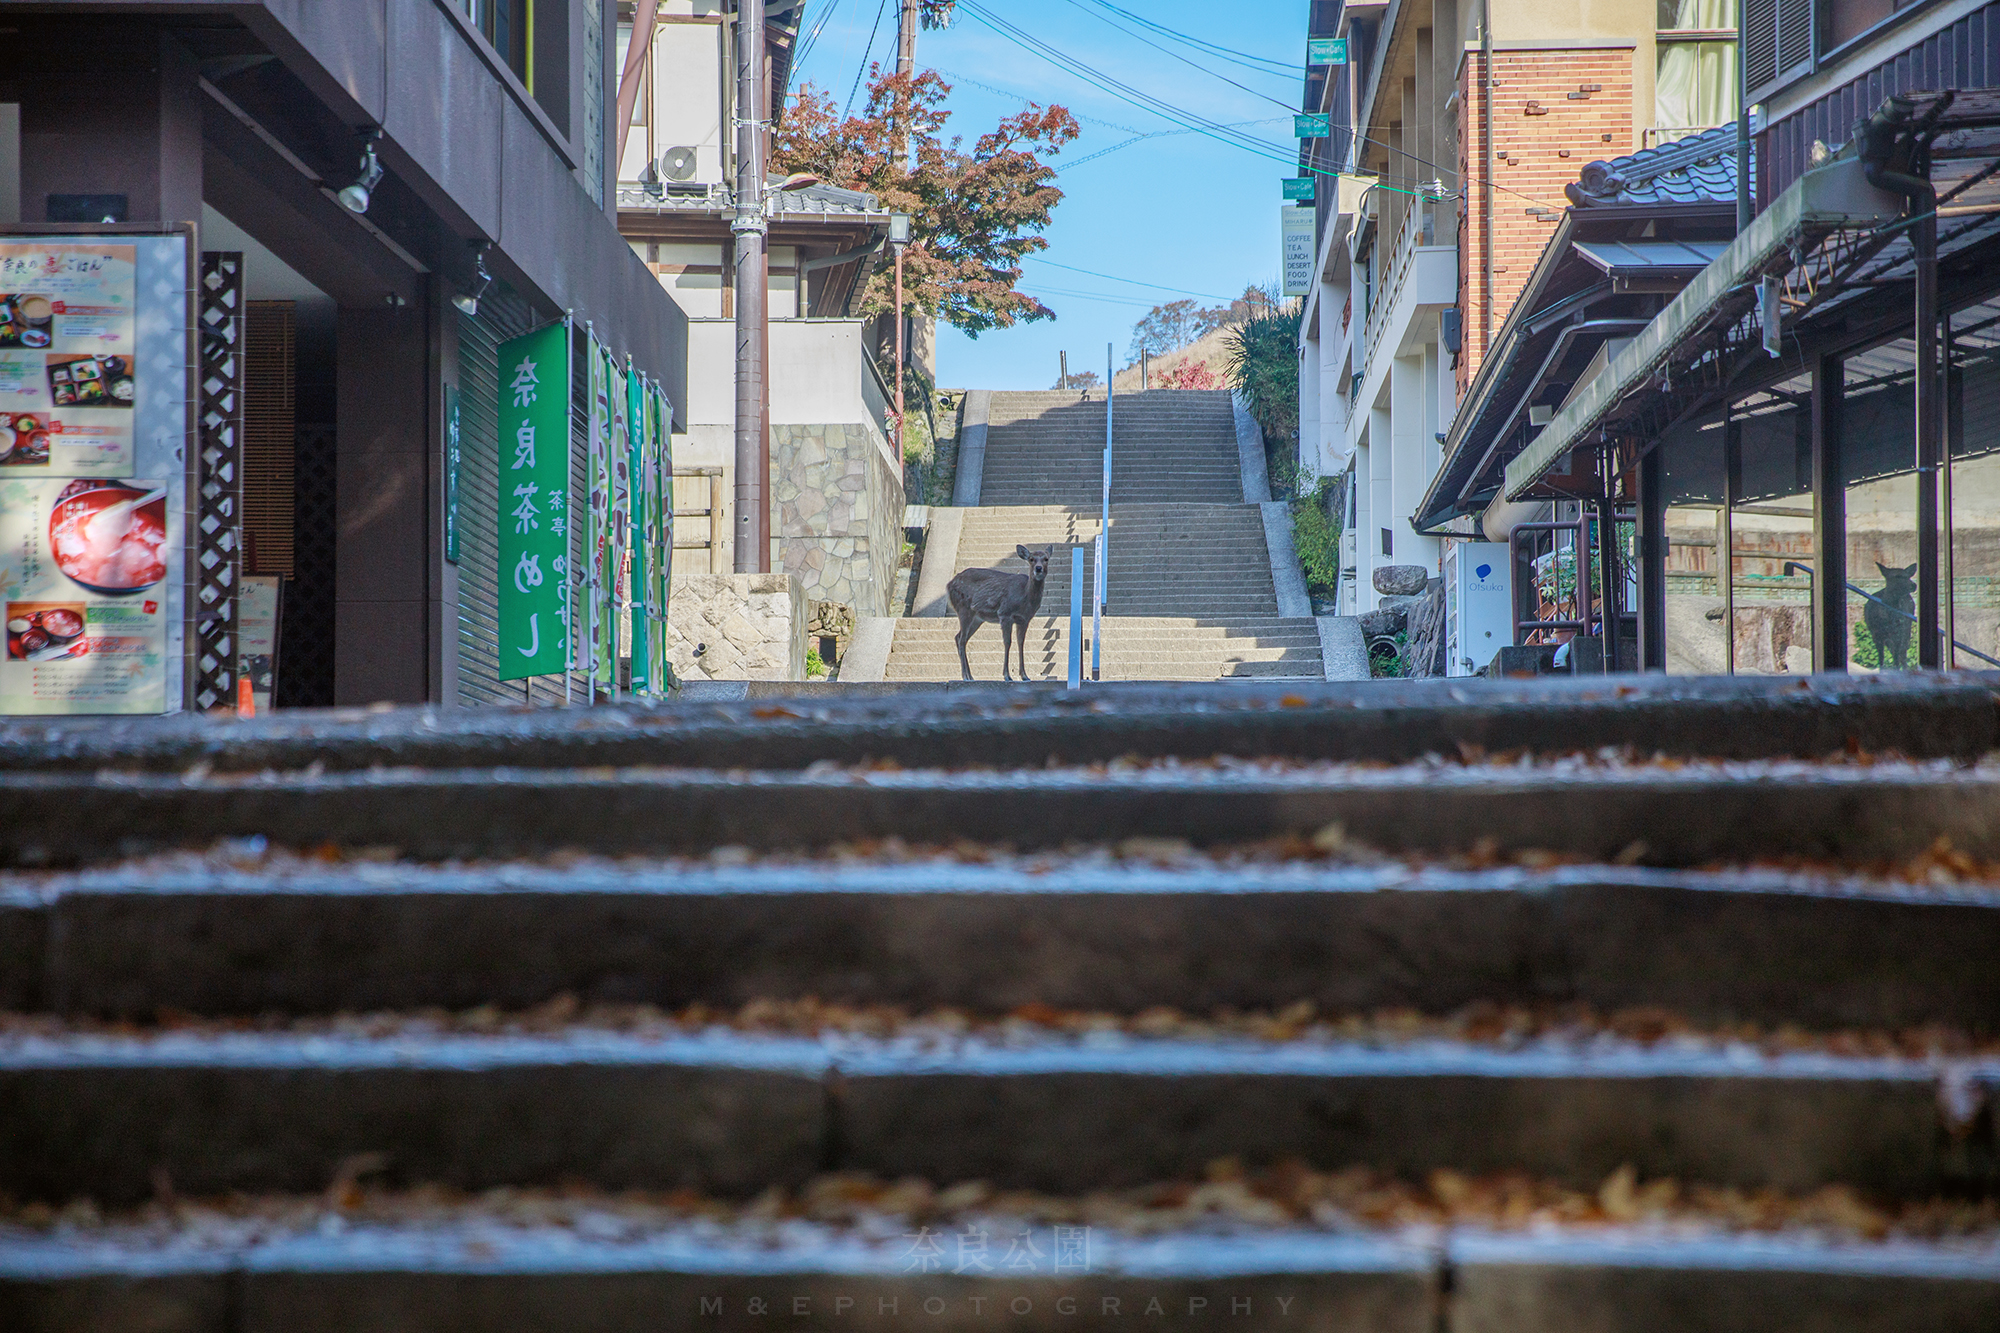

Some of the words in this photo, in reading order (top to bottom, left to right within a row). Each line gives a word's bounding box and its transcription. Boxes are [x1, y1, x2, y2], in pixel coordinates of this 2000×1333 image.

[1287, 234, 1312, 242] COFFEE
[1287, 253, 1309, 261] LUNCH
[1287, 280, 1309, 288] DRINK
[1469, 582, 1504, 592] Otsuka
